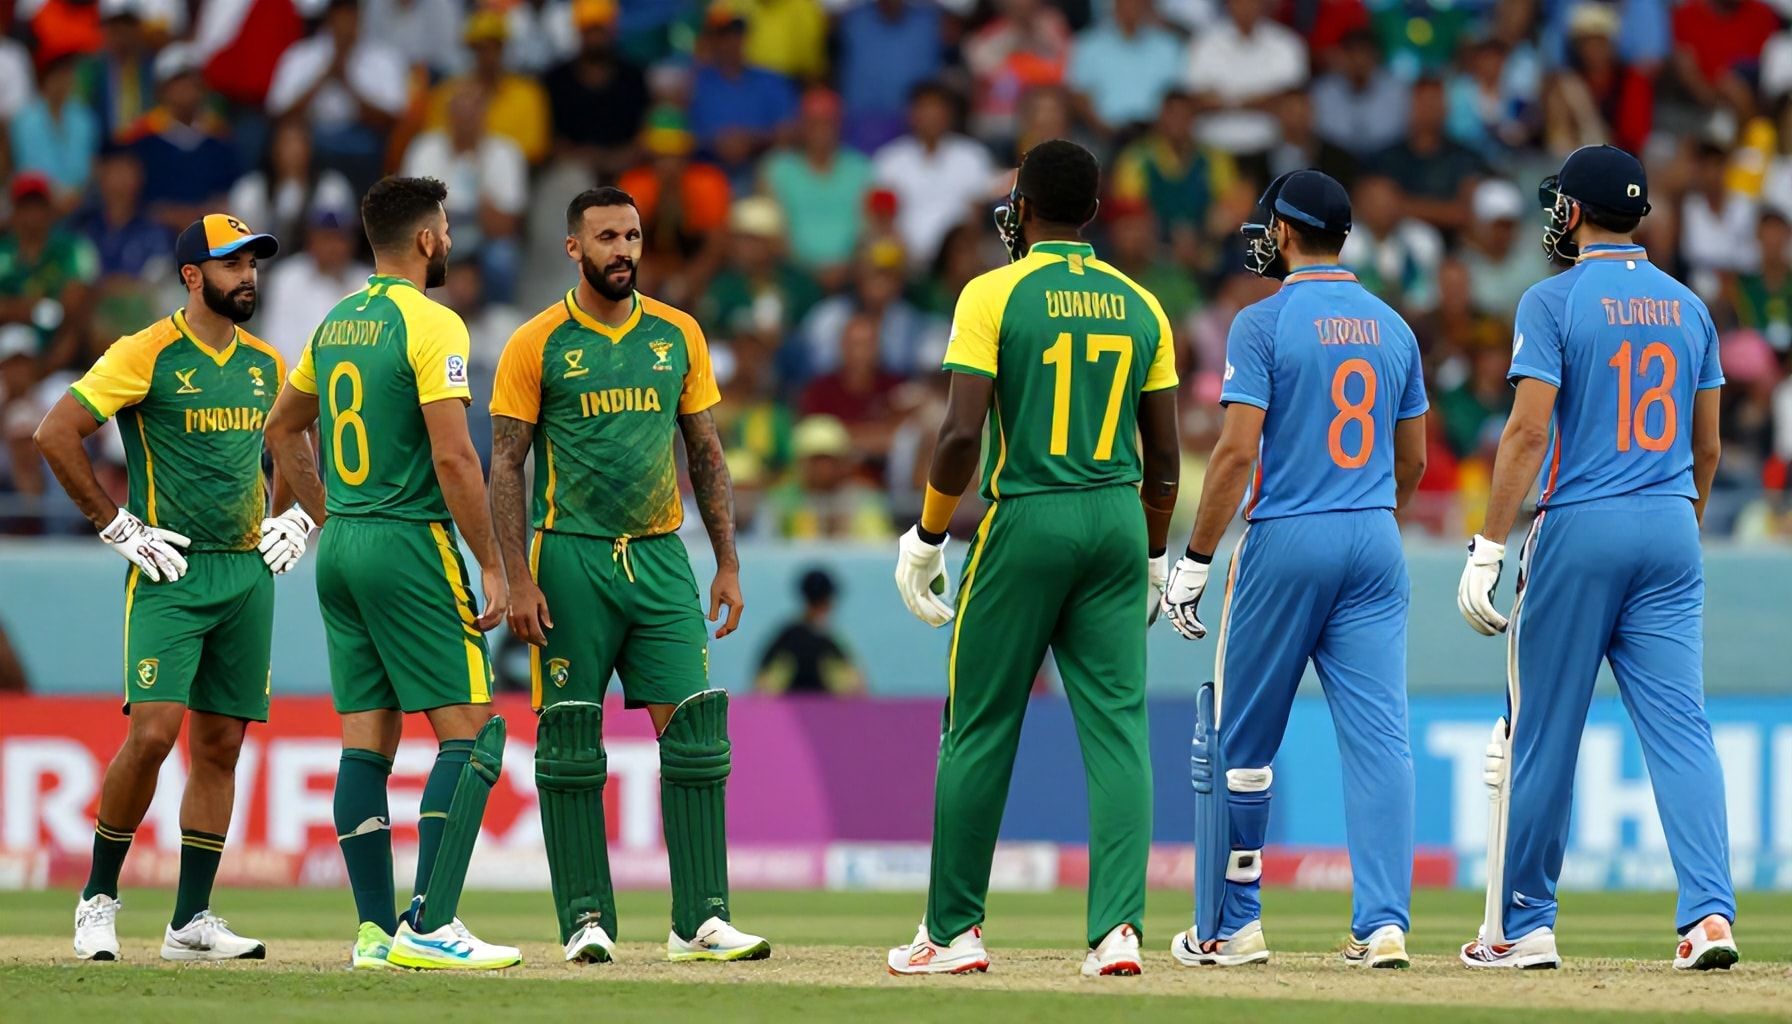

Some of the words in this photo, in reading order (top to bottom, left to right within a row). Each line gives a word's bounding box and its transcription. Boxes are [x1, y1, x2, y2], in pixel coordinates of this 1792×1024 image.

[328, 360, 370, 487] 8
[1042, 331, 1133, 461] 17
[1327, 357, 1378, 470] 8
